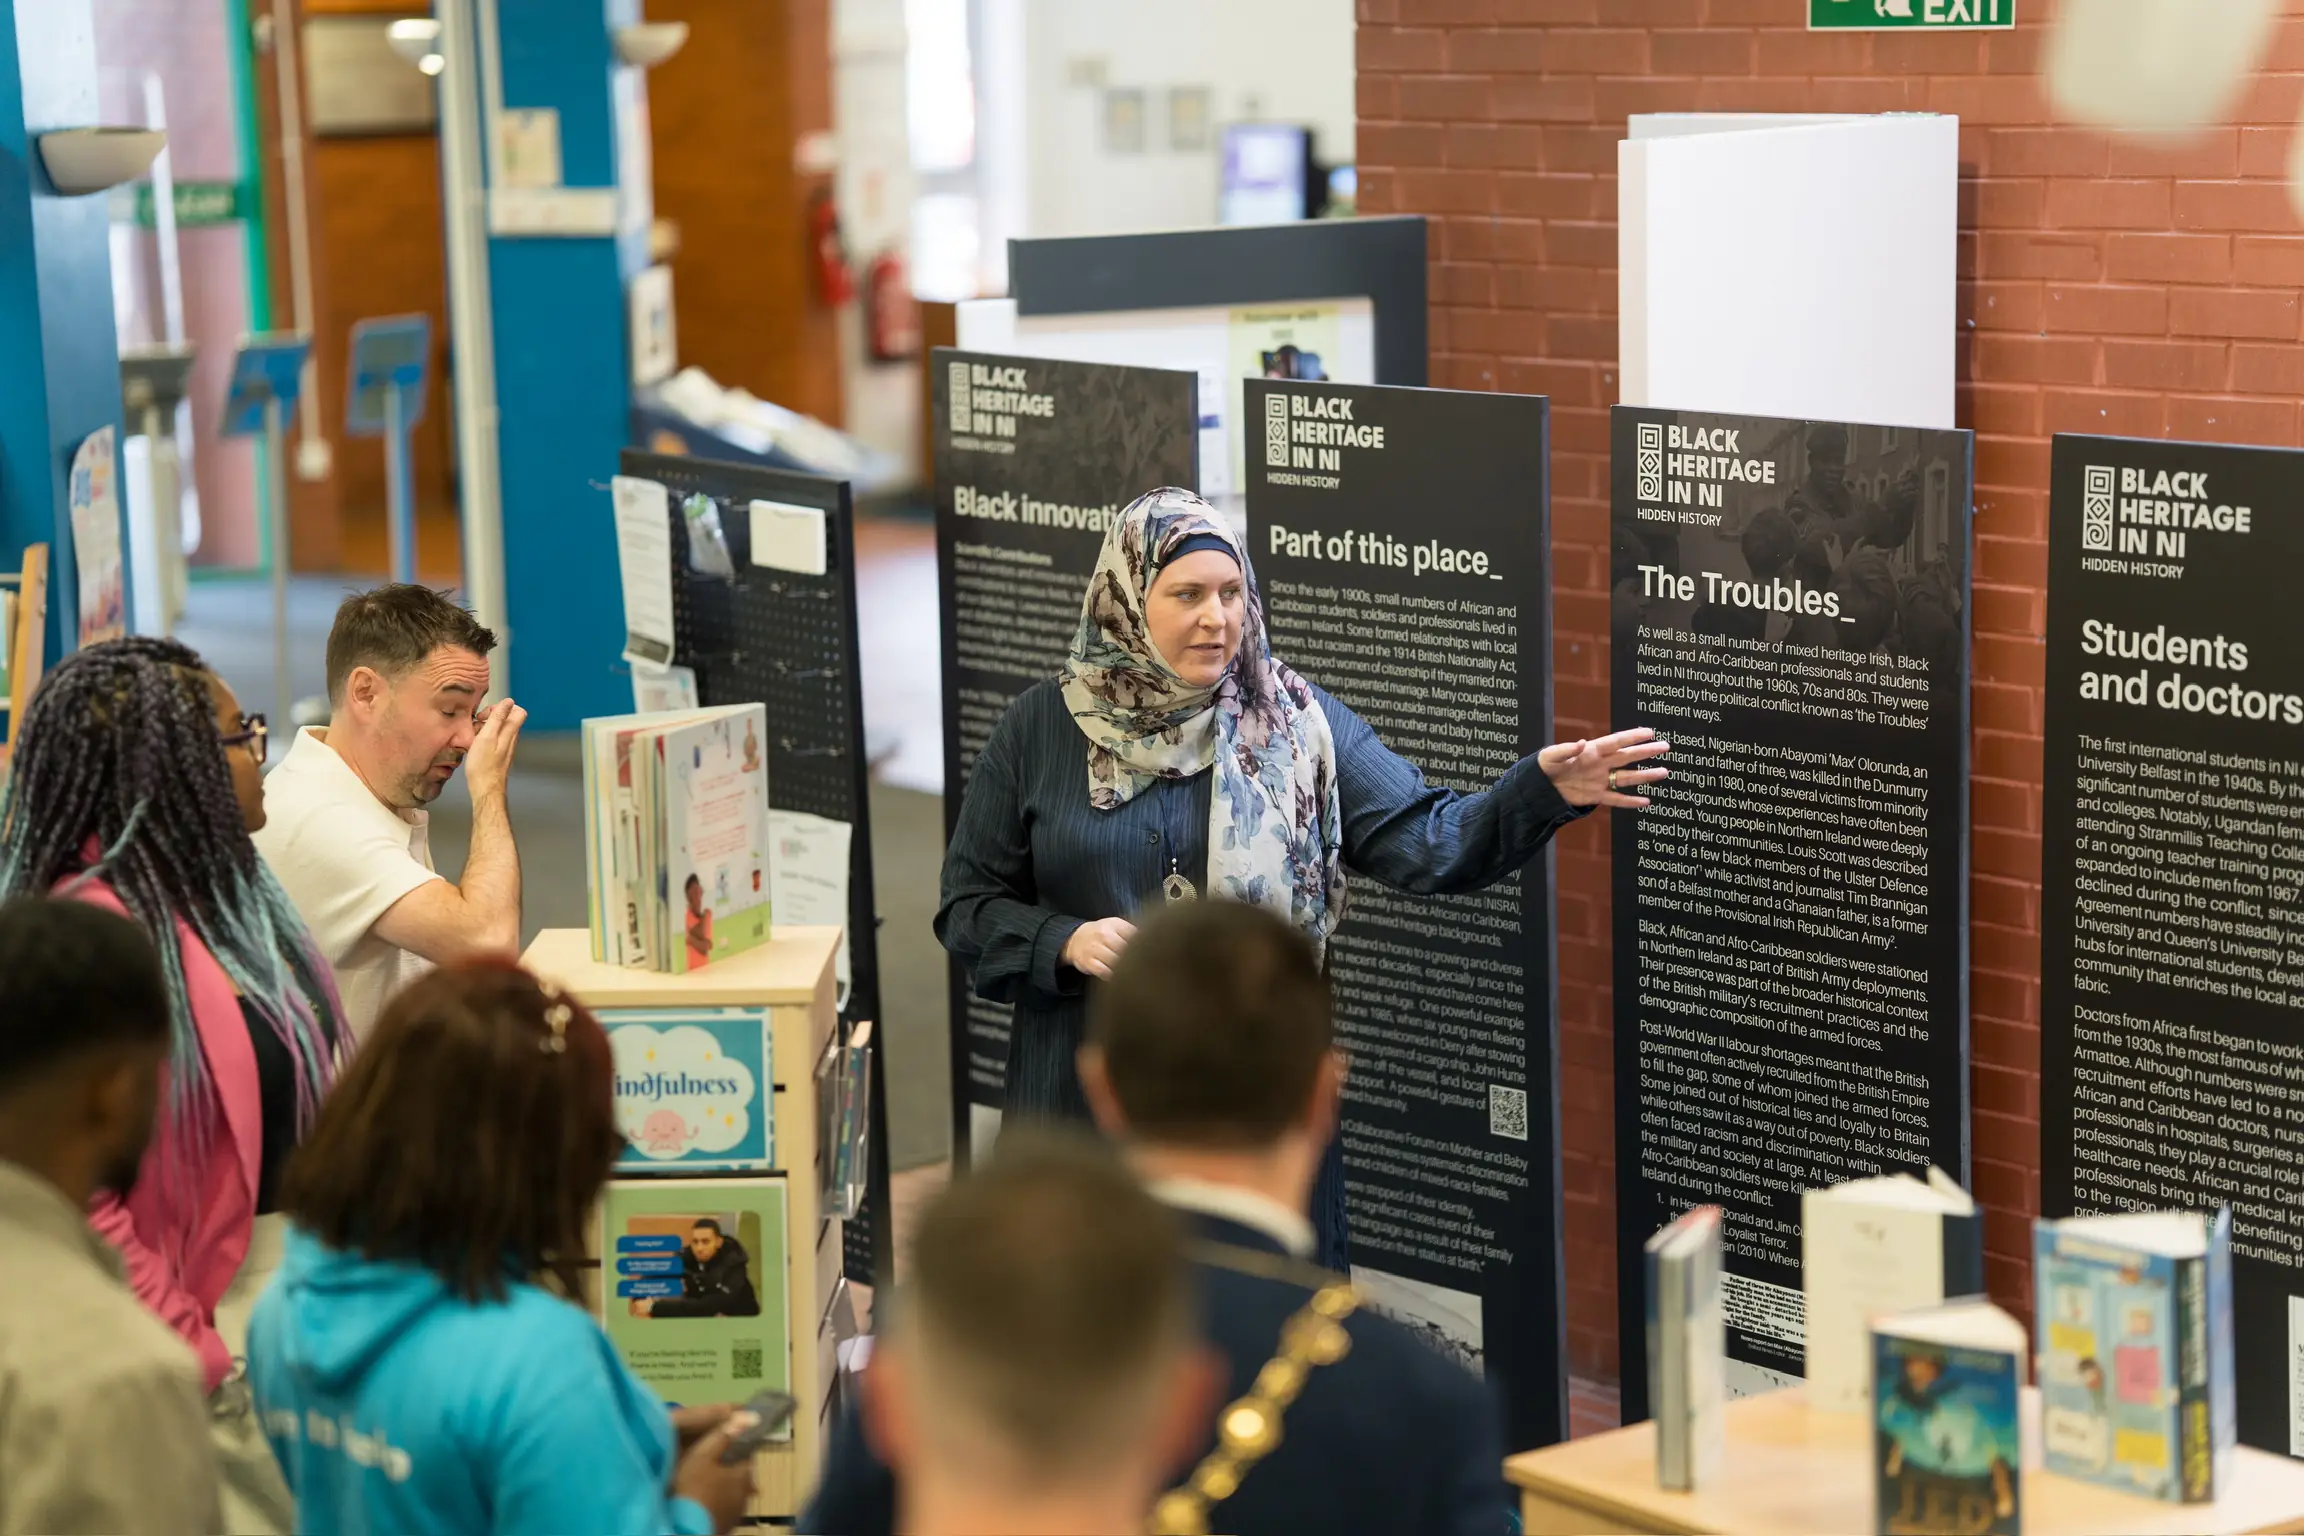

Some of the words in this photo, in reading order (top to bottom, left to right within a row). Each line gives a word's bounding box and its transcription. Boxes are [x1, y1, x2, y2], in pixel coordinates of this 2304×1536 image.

[972, 365, 1026, 390] BLACK
[972, 389, 1053, 416] HERITAGE
[1291, 395, 1353, 420] BLACK
[973, 413, 992, 434] IN
[996, 415, 1015, 436] NI
[1292, 420, 1383, 448] HERITAGE
[1668, 425, 1739, 453] BLACK
[1292, 446, 1313, 468] IN
[1319, 448, 1339, 470] NI
[1668, 453, 1775, 484] HERITAGE
[1267, 472, 1300, 485] HIDDEN
[1302, 475, 1340, 488] HISTORY
[1668, 480, 1691, 504] IN
[1699, 483, 1722, 507] NI
[2121, 467, 2208, 499] BLACK
[954, 486, 1017, 521] Black
[1638, 508, 1675, 522] HIDDEN
[1678, 511, 1722, 526] HISTORY
[2120, 498, 2250, 532] HERITAGE
[1270, 525, 1321, 559] Part
[1327, 530, 1353, 561] of
[1357, 532, 1407, 567] this
[2119, 527, 2147, 554] IN
[2156, 530, 2185, 557] NI
[1638, 565, 1694, 600] The
[2082, 557, 2127, 573] HIDDEN
[2131, 561, 2184, 578] HISTORY
[1298, 583, 1313, 596] the
[1315, 586, 1338, 601] early
[1374, 593, 1399, 605] small
[1402, 596, 1445, 610] numbers
[1447, 599, 1456, 611] of
[1460, 600, 1494, 615] African
[1497, 606, 1516, 617] and
[1347, 623, 1373, 638] Some
[1375, 625, 1408, 642] formed
[1411, 631, 1469, 650] relationships
[1471, 639, 1491, 651] with
[1494, 640, 1517, 654] local
[1637, 624, 1650, 638] As
[1652, 627, 1673, 640] well
[1676, 631, 1687, 642] as
[1690, 632, 1696, 643] a
[1699, 633, 1725, 647] small
[1728, 638, 1770, 652] number
[1772, 640, 1783, 653] of
[1786, 644, 1818, 657] mixed
[1821, 646, 1866, 666] heritage
[1870, 652, 1894, 668] Irish,
[1898, 655, 1929, 670] Black
[2081, 619, 2247, 670] Students
[1637, 643, 1672, 658] African
[1675, 649, 1695, 661] and
[1698, 650, 1777, 671] Afro-Caribbean
[1781, 662, 1852, 681] professionals
[1855, 671, 1876, 684] and
[1880, 674, 1929, 691] students
[1637, 661, 1661, 675] lived
[1663, 665, 1672, 677] in
[1674, 666, 1684, 678] NI
[1687, 668, 1744, 687] throughout
[1746, 675, 1763, 689] the
[1766, 678, 1799, 695] 1960s,
[1802, 682, 1822, 697] 70s
[1823, 687, 1844, 699] and
[1846, 688, 1868, 703] 80s.
[1871, 691, 1899, 709] They
[1900, 697, 1928, 710] were
[1637, 680, 1684, 698] impacted
[1687, 686, 1699, 702] by
[1701, 688, 1718, 702] the
[1720, 692, 1759, 708] political
[1761, 698, 1800, 713] conflict
[1802, 701, 1838, 718] known
[1840, 709, 1853, 720] as
[2080, 669, 2147, 705] and
[1637, 699, 1646, 711] in
[1648, 700, 1690, 717] different
[1693, 708, 1721, 723] ways.
[2078, 734, 2101, 750] The
[2104, 737, 2126, 753] first
[2129, 741, 2206, 764] international
[2209, 753, 2266, 771] students
[2269, 759, 2280, 773] in
[2284, 761, 2298, 775] NI
[2078, 754, 2137, 778] University
[2140, 763, 2181, 781] Belfast
[2184, 769, 2195, 783] in
[2199, 770, 2219, 787] the
[2224, 774, 2265, 793] 1940s.
[2269, 779, 2286, 799] By
[1639, 919, 1667, 937] Black,
[1669, 925, 1704, 942] African
[1706, 934, 1725, 946] and
[1727, 936, 1804, 960] Afro-Caribbean
[1806, 951, 1847, 968] soldiers
[1848, 959, 1875, 973] were
[1877, 964, 1927, 983] stationed
[2074, 973, 2111, 995] fabric.
[2075, 1005, 2121, 1025] Doctors
[2123, 1013, 2150, 1031] from
[2152, 1019, 2187, 1038] Africa
[2189, 1025, 2211, 1043] first
[2213, 1030, 2254, 1051] began
[2257, 1039, 2270, 1053] to
[1640, 1019, 1694, 1041] Post-World
[1696, 1031, 1717, 1045] War
[1726, 1036, 1759, 1054] labour
[1761, 1044, 1814, 1066] shortages
[1815, 1057, 1849, 1073] meant
[1852, 1062, 1872, 1078] that
[1875, 1066, 1892, 1082] the
[1895, 1070, 1928, 1089] British
[615, 1071, 738, 1101] indfulness
[1642, 1165, 1676, 1184] Ireland
[1678, 1173, 1712, 1195] during
[1714, 1182, 1731, 1196] the
[1733, 1189, 1773, 1206] conflict.
[1724, 1226, 1757, 1242] Loyalist
[1759, 1232, 1788, 1249] Terror.
[1737, 1242, 1766, 1260] (2010)
[1768, 1251, 1799, 1267] Where
